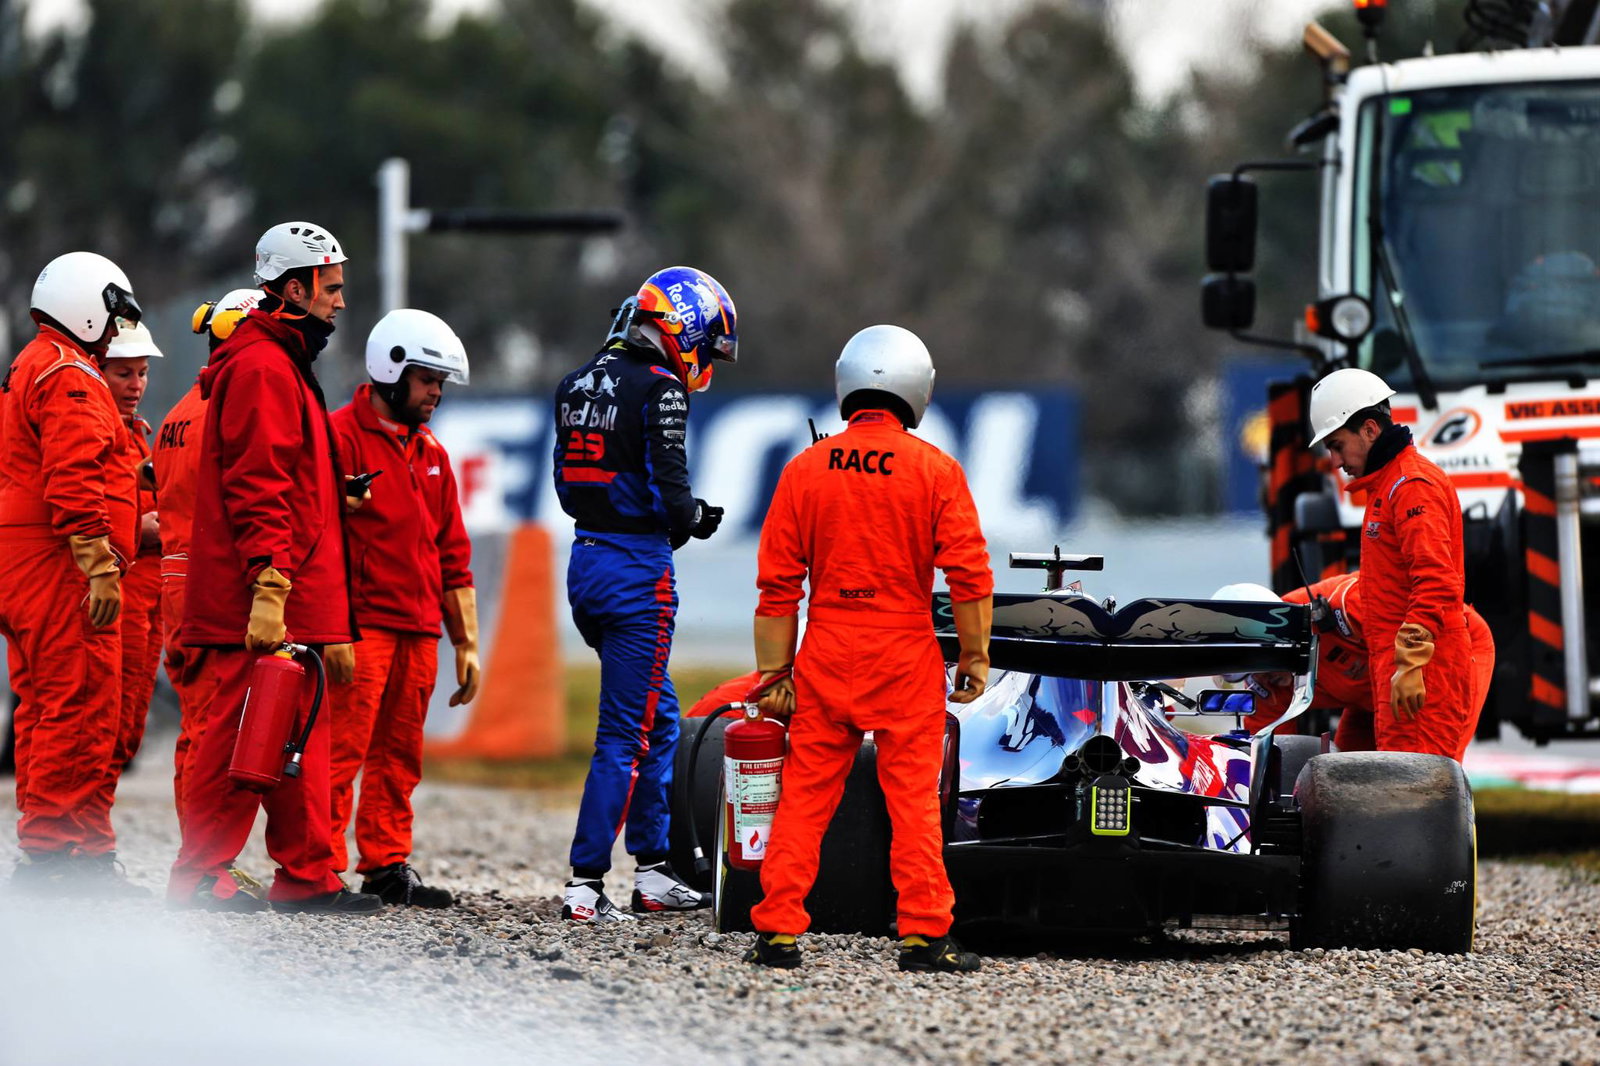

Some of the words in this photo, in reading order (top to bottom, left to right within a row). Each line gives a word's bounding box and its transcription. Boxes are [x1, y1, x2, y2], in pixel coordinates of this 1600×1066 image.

[666, 282, 693, 314] Red
[681, 310, 704, 343] Bull
[561, 401, 591, 428] Red
[588, 404, 619, 431] Bull
[1509, 406, 1544, 419] VIC
[160, 420, 191, 450] RACC
[828, 448, 895, 476] RACC
[1406, 505, 1426, 518] RACC
[575, 905, 595, 916] 23
